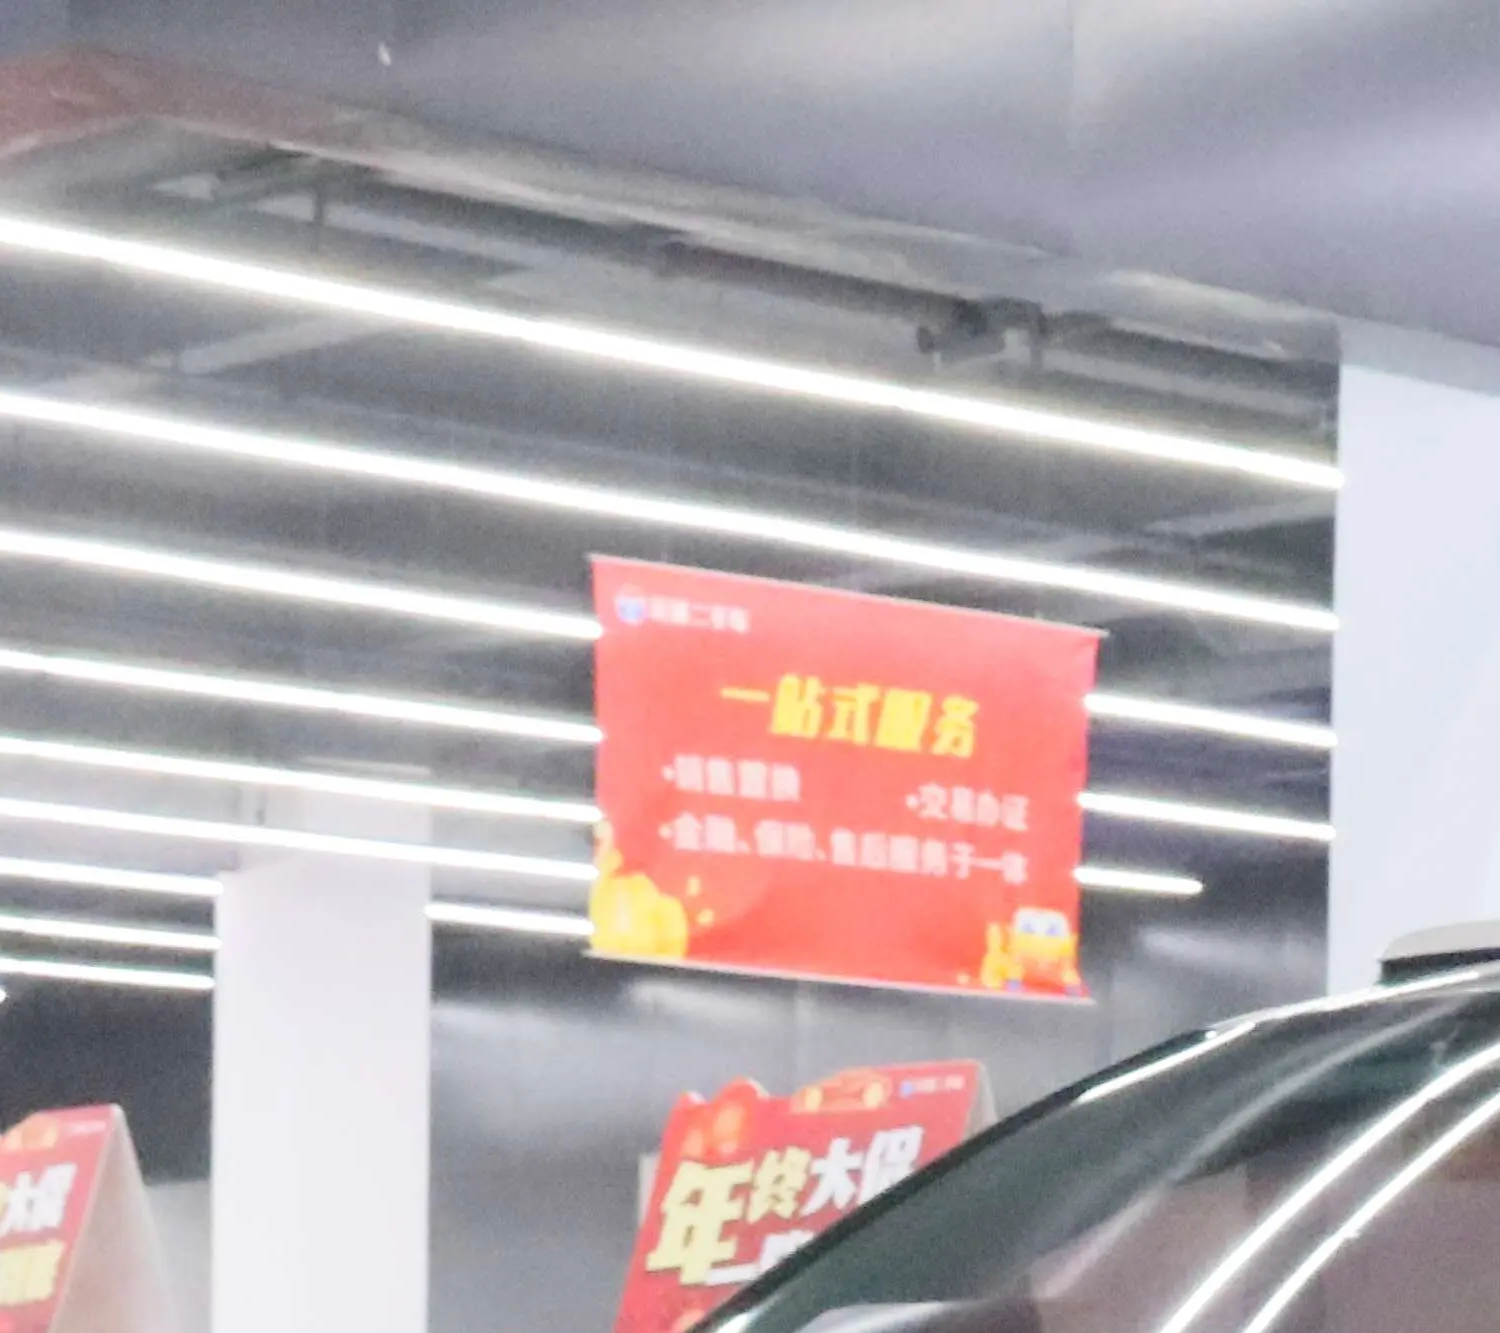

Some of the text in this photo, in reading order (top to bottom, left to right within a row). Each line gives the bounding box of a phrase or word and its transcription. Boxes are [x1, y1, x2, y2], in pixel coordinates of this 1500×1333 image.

[719, 673, 980, 759] 一站式服务
